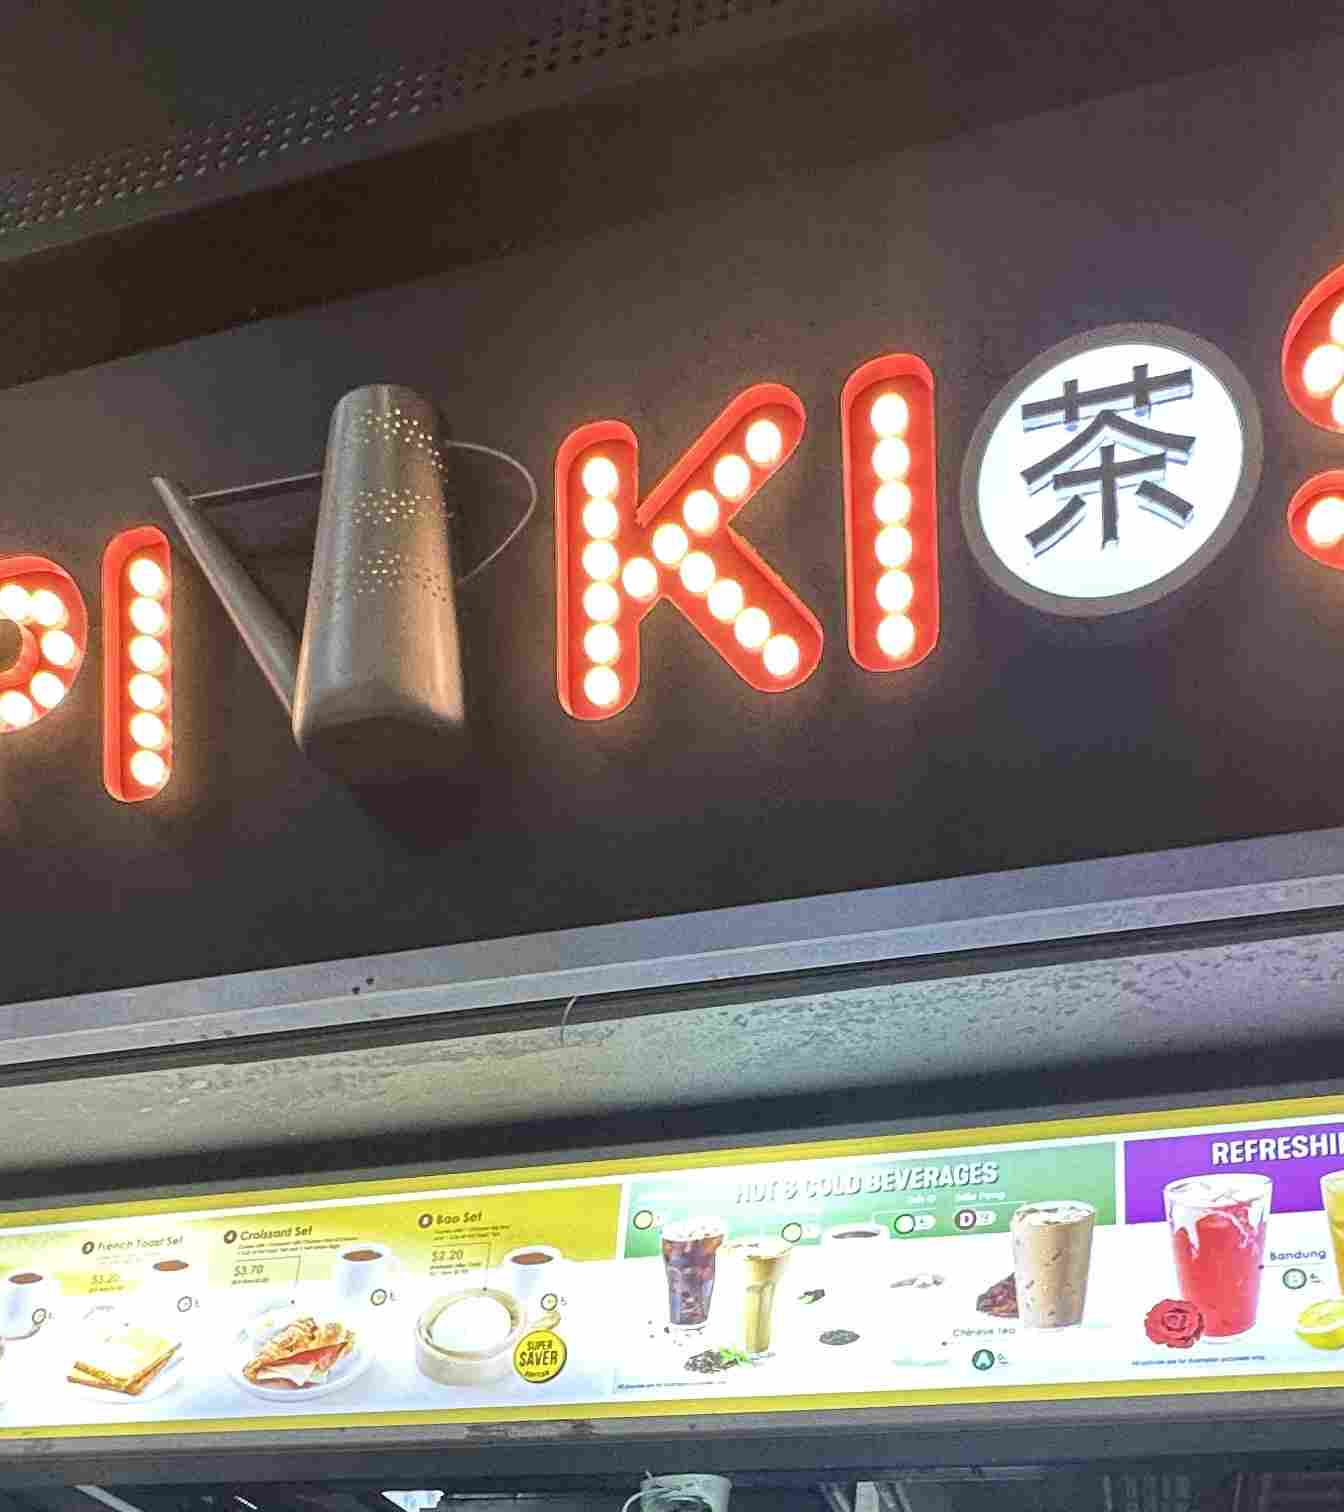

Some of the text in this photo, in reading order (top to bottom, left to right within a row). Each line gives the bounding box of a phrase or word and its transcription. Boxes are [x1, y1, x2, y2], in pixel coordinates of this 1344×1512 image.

[1020, 365, 1197, 555] 茶
[865, 1161, 1000, 1194] BEVERAGES
[463, 1211, 483, 1224] Set
[295, 1225, 313, 1237] Set
[1269, 1249, 1327, 1262] Bandung
[519, 1351, 558, 1367] SAVER
